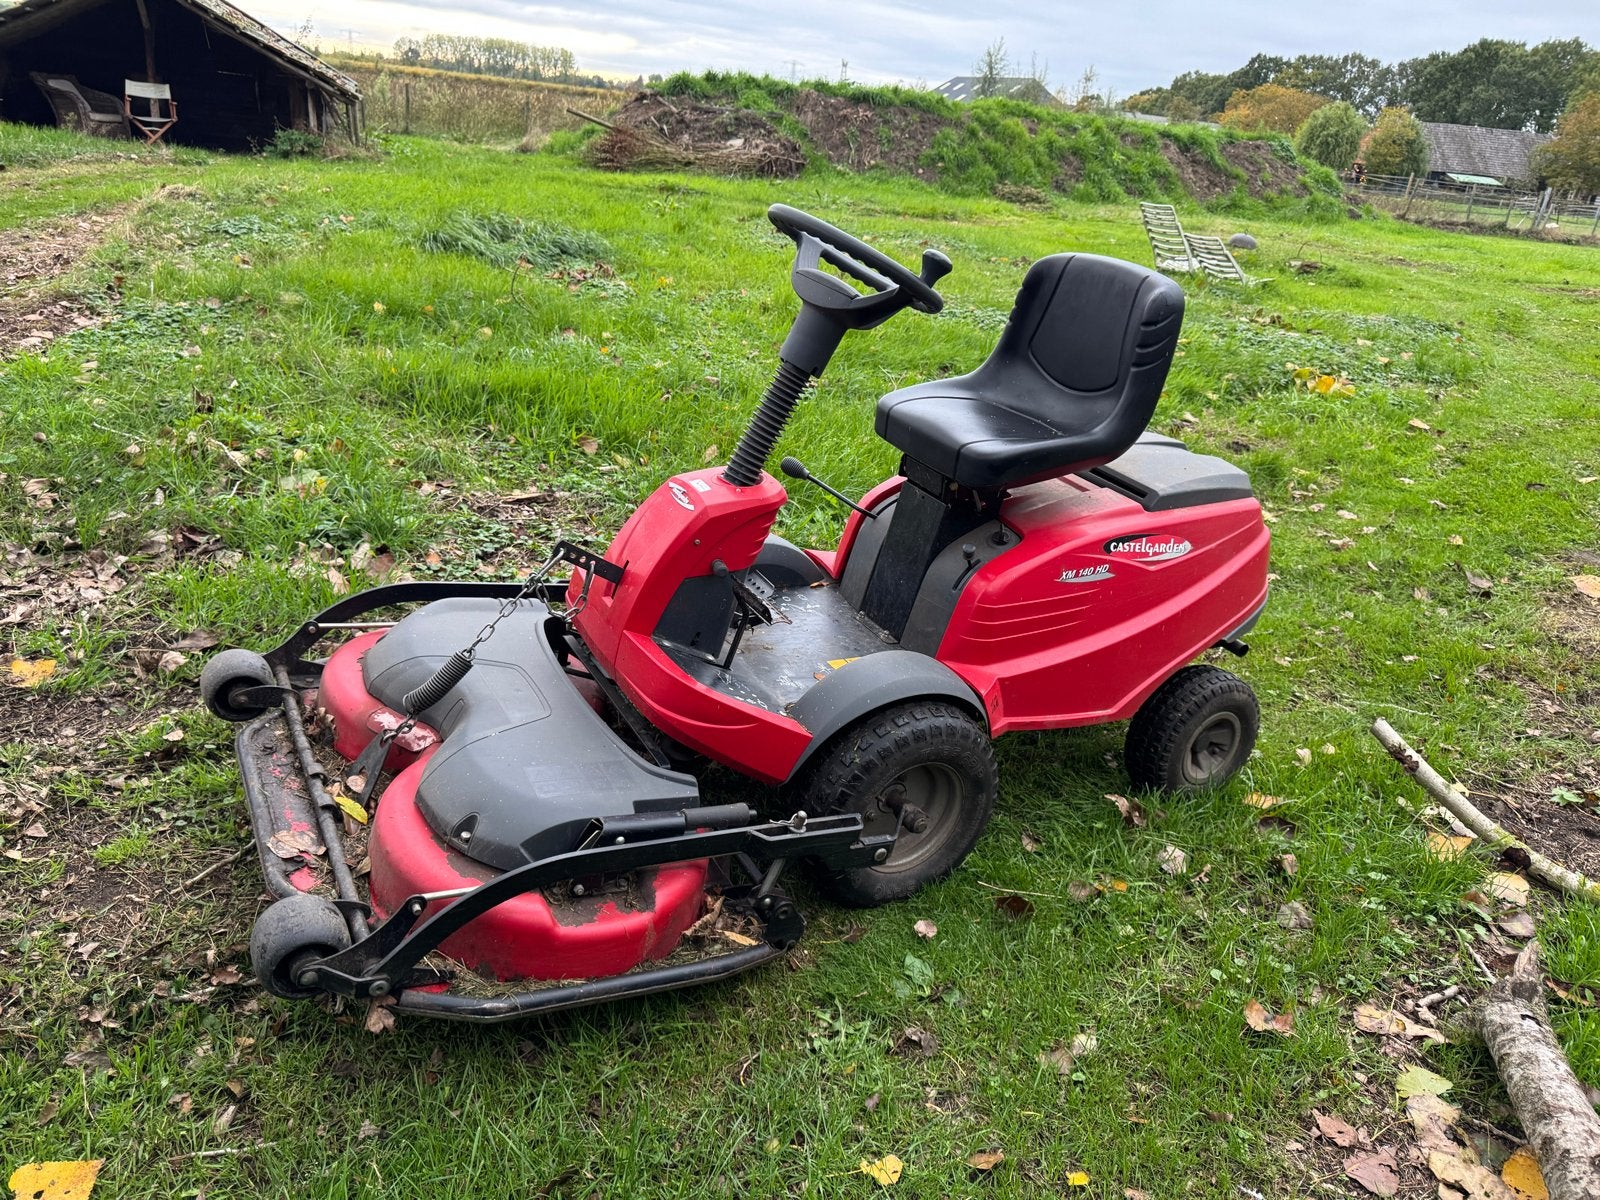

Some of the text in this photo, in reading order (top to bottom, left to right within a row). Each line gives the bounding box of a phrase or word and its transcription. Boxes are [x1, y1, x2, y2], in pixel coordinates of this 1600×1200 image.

[1060, 564, 1109, 581] XM 140 HD
